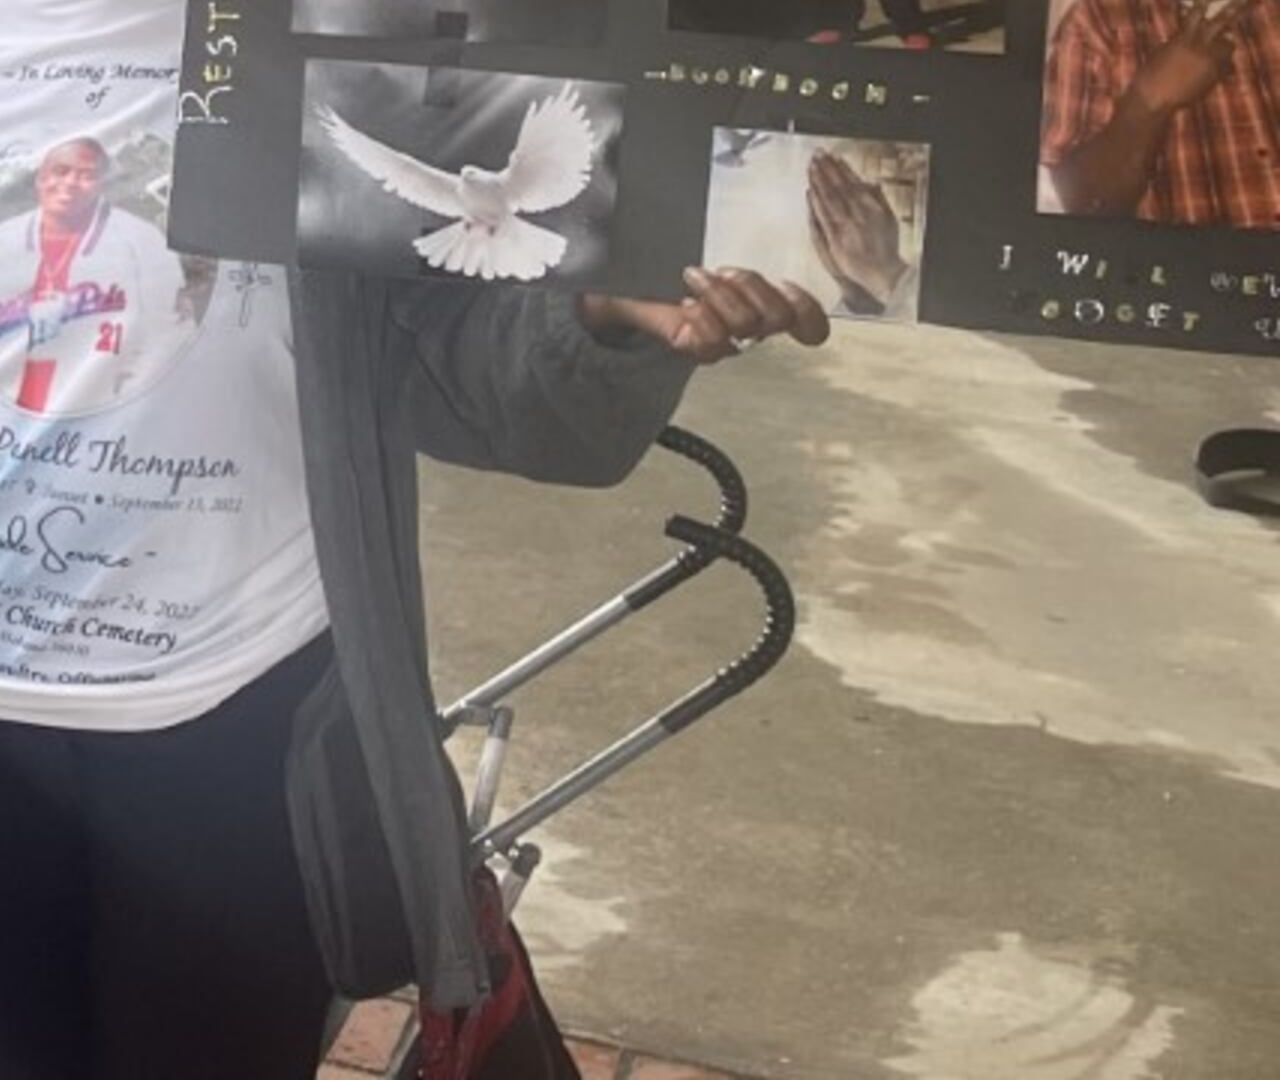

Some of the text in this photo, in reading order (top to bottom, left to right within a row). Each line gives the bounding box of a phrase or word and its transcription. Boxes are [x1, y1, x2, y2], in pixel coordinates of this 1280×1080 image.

[85, 86, 111, 110] of
[95, 321, 124, 355] 21
[4, 604, 77, 637] Church
[80, 617, 178, 656] Cemetery
